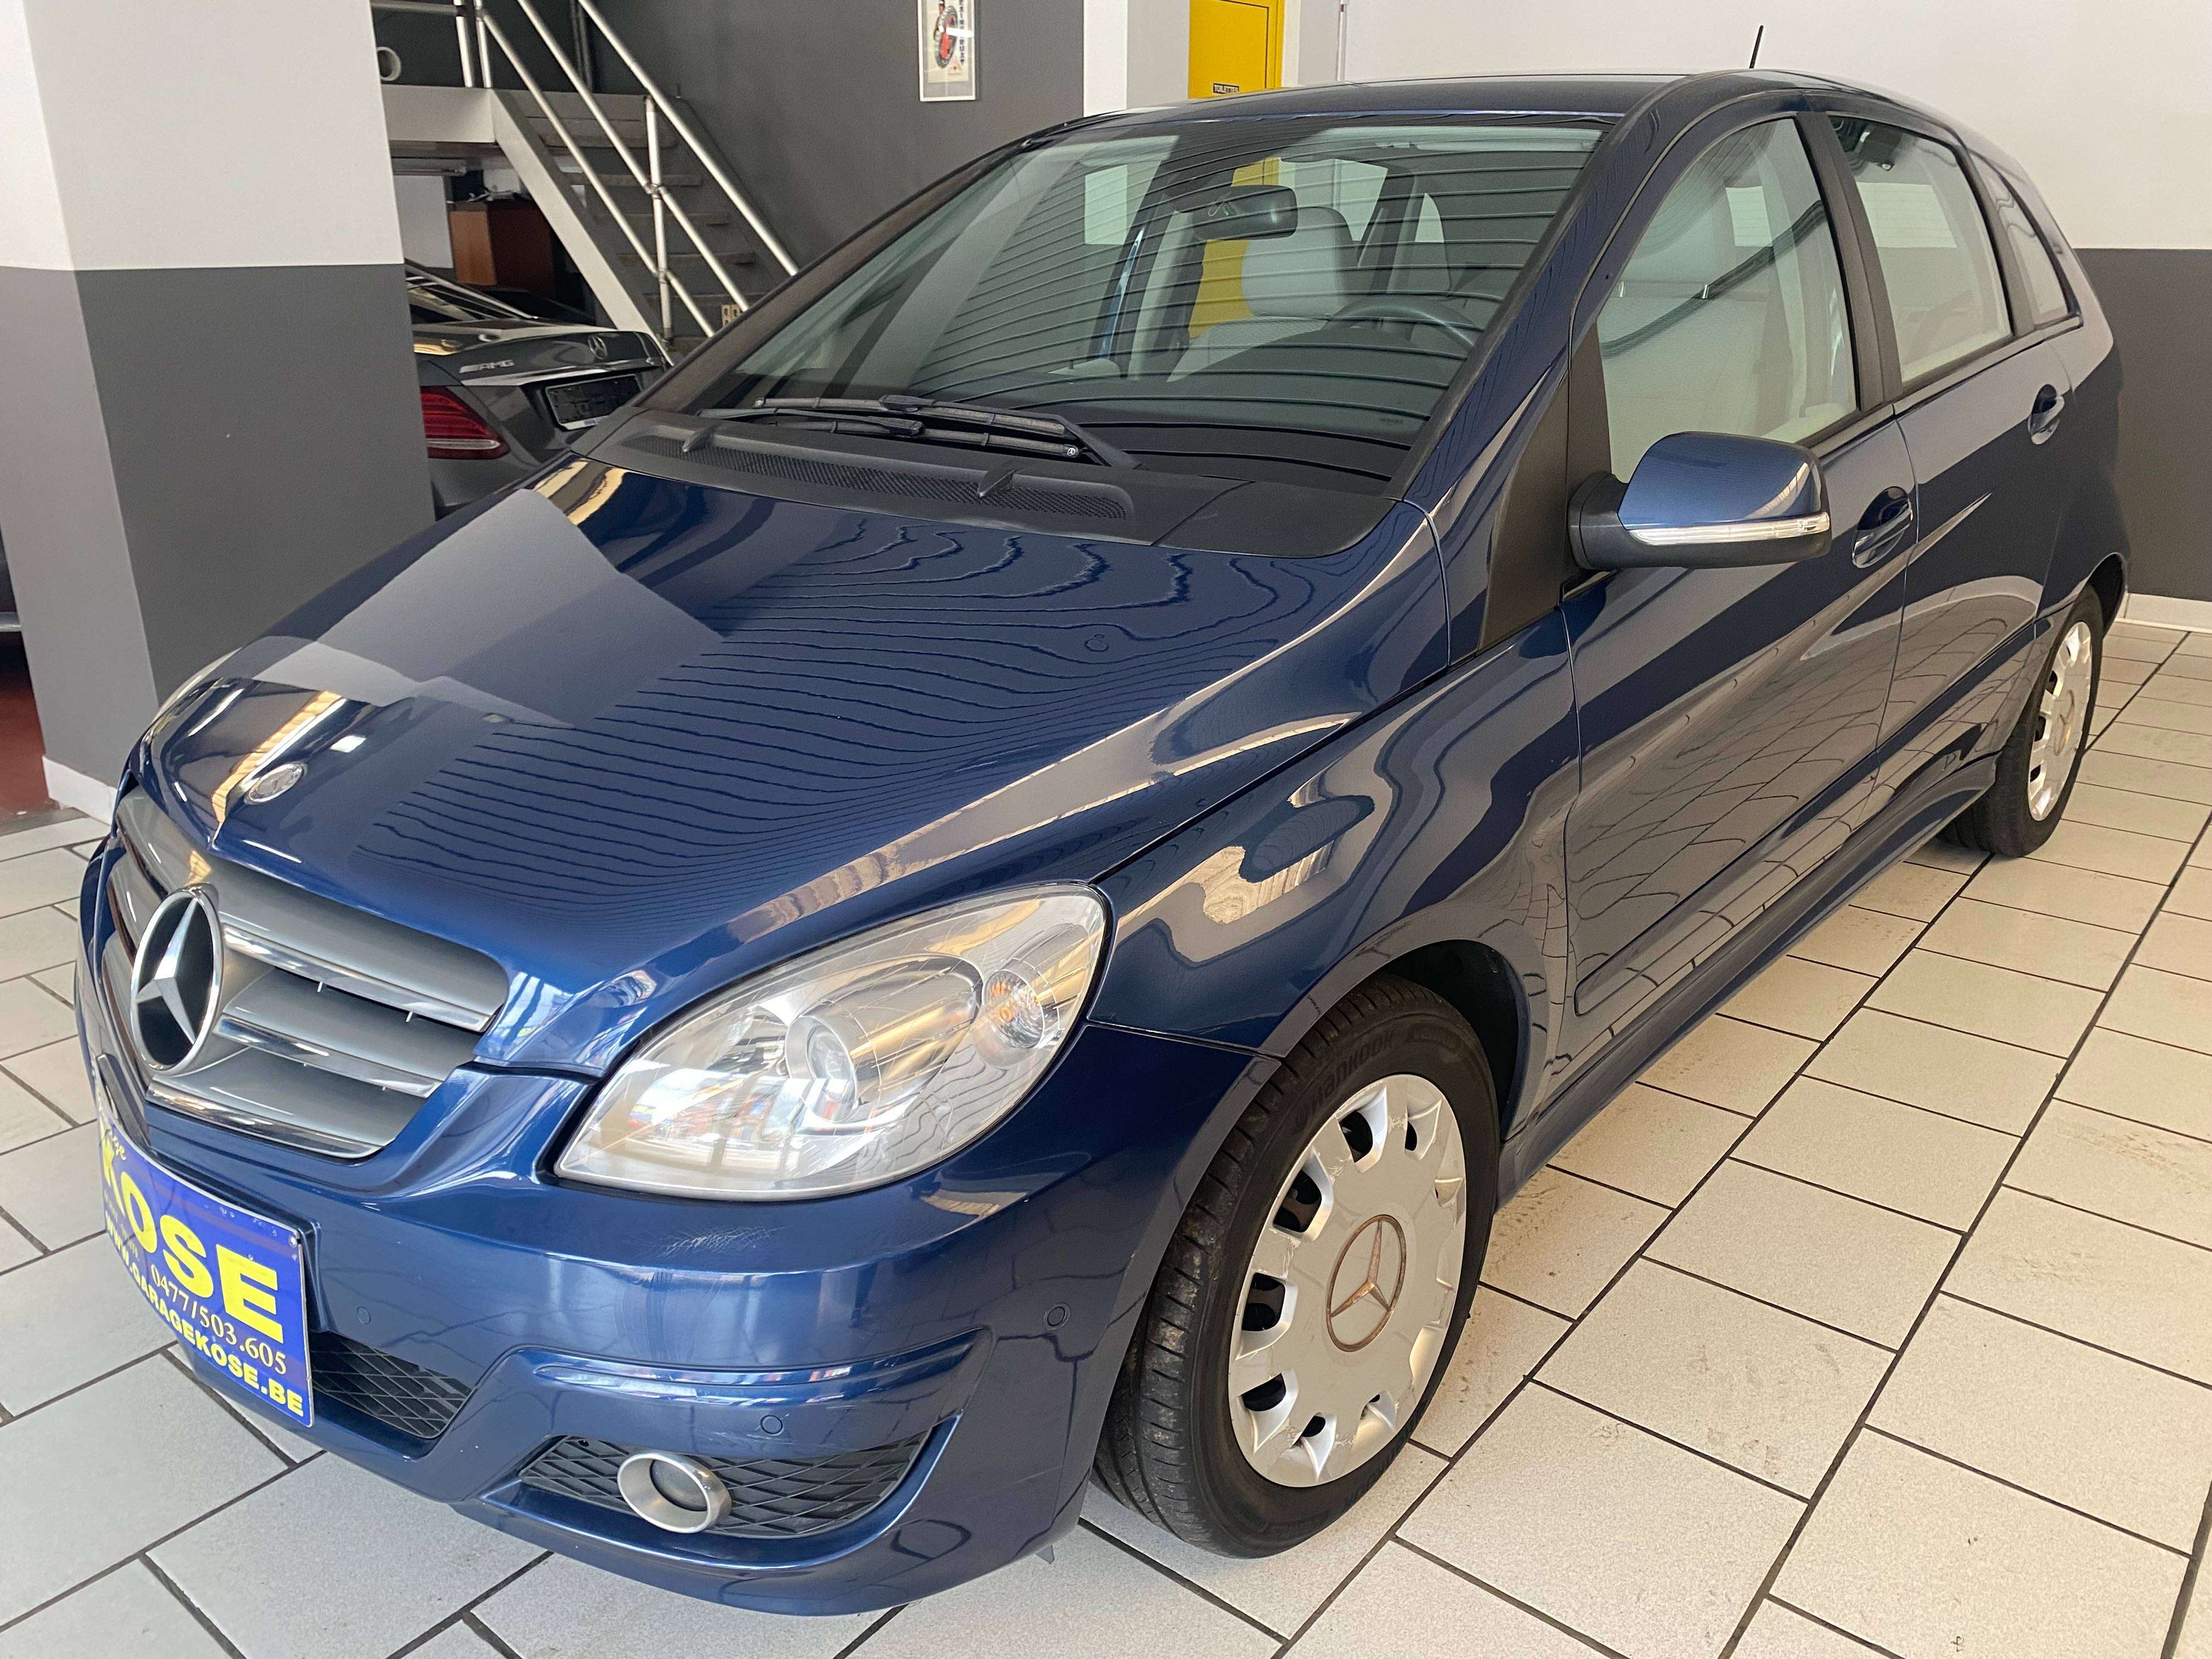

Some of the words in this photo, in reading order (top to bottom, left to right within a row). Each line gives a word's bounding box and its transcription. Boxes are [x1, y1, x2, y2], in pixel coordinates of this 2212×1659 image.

[478, 360, 514, 370] AMG
[99, 1116, 284, 1344] KOSE
[105, 1210, 303, 1417] WWW.GARAGEKOSE.BE
[150, 1263, 286, 1375] 0477/503.605
